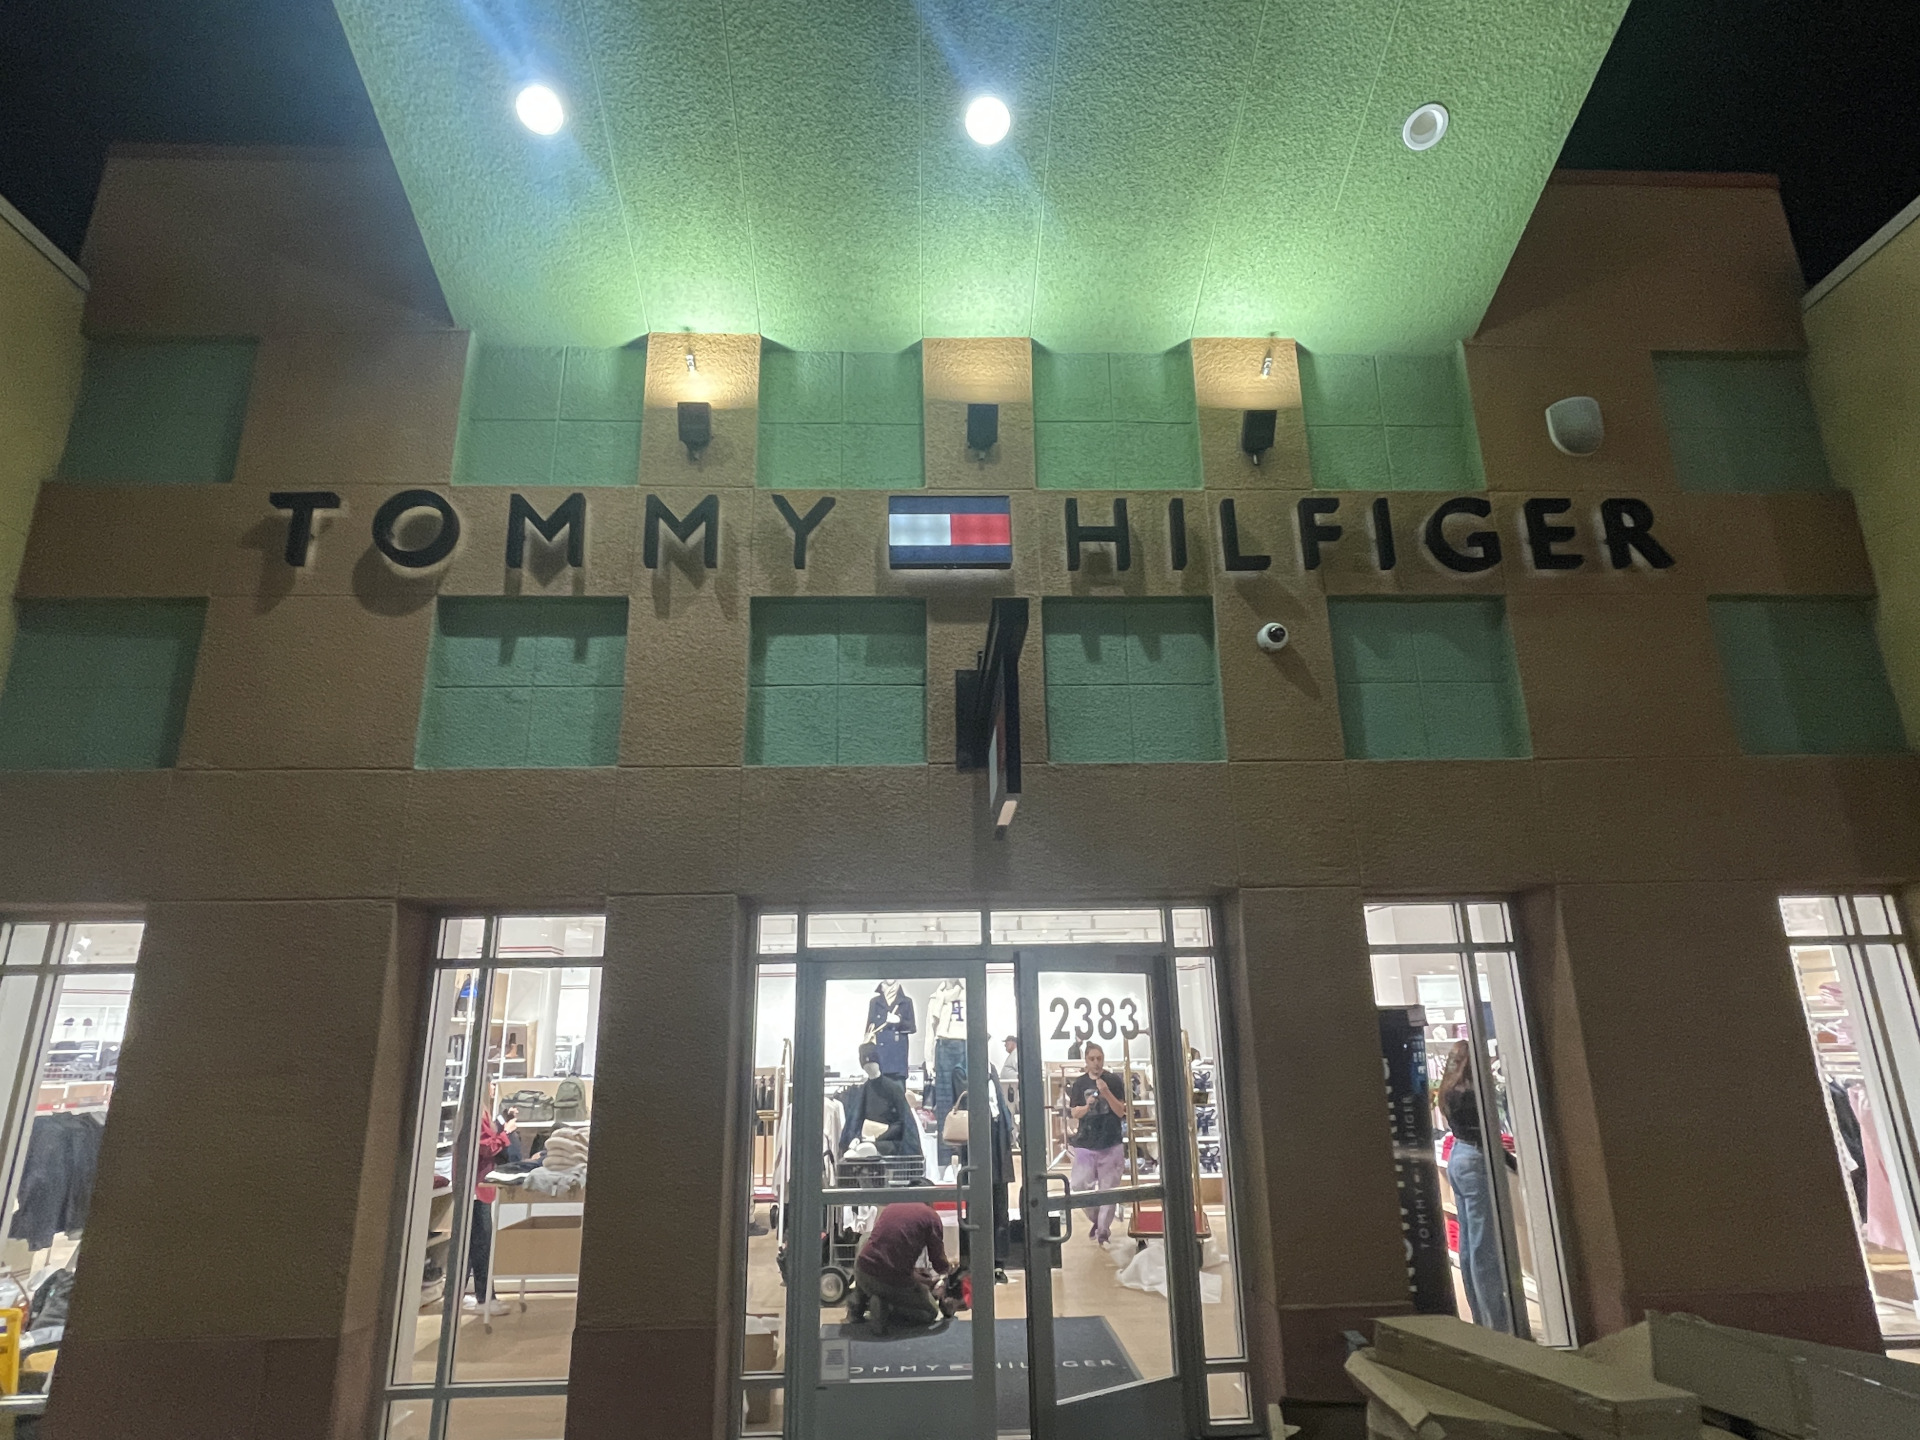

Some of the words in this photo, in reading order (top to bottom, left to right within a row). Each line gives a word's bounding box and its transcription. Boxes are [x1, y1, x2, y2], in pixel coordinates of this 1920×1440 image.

[269, 489, 836, 570] TOMMY
[1065, 496, 1676, 572] HILFIGER
[1049, 997, 1139, 1040] 2383
[849, 1364, 939, 1373] OMMY
